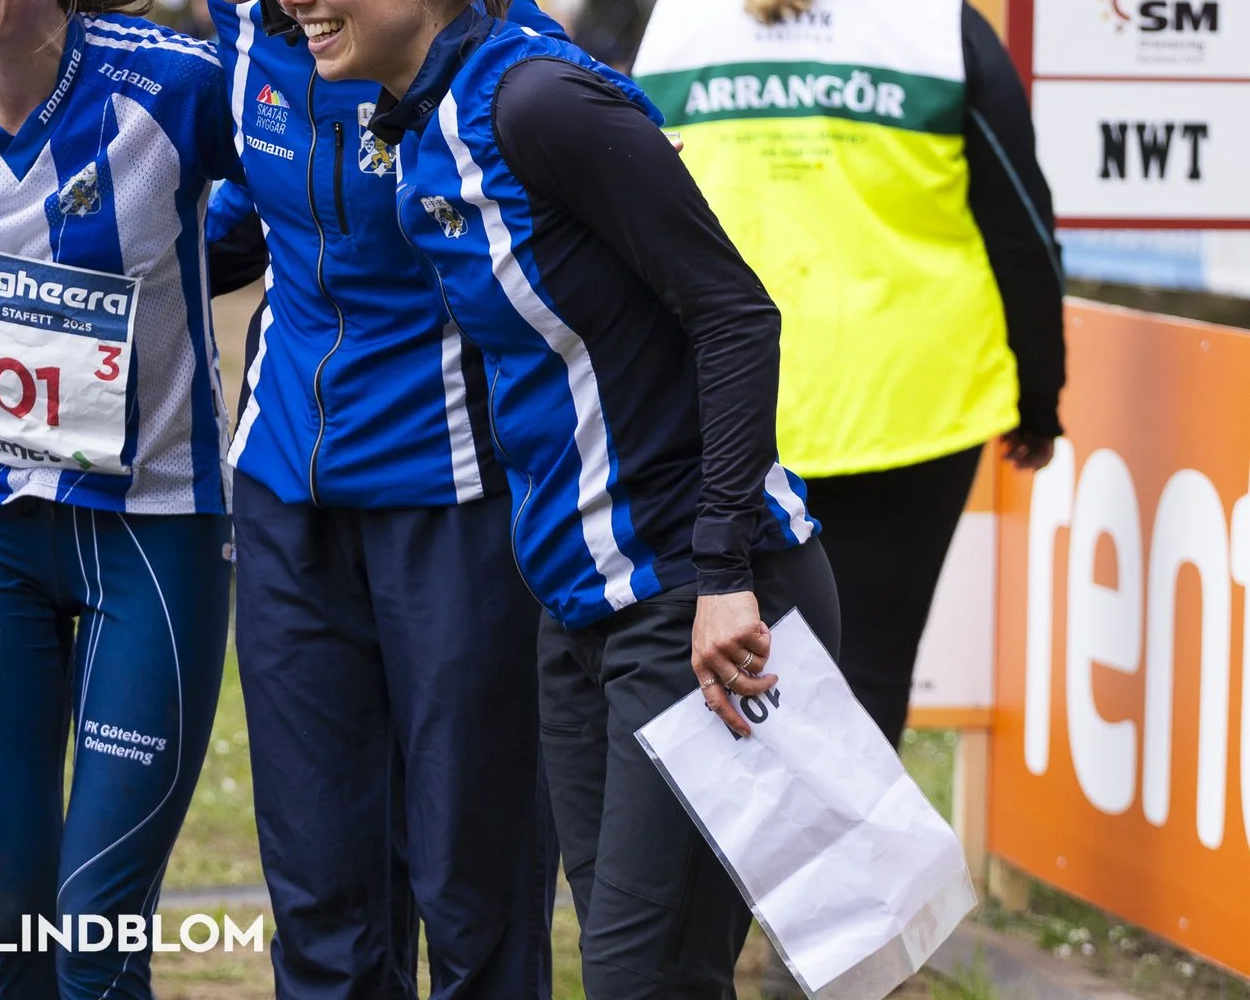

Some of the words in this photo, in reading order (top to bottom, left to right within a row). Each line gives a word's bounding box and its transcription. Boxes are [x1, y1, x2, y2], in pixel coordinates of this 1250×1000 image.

[1138, 0, 1219, 32] SM
[38, 48, 82, 125] noname
[684, 72, 906, 119] ARRANGÖR
[255, 117, 286, 135] RYGGAR
[257, 104, 289, 123] SKATÅS
[246, 135, 295, 161] noname
[1099, 121, 1209, 181] NWT
[2, 306, 53, 325] STAFETT
[62, 318, 92, 333] 2025
[94, 345, 122, 381] 3
[84, 720, 98, 735] IFK
[100, 723, 167, 751] Göteborg
[84, 736, 155, 765] Orientering
